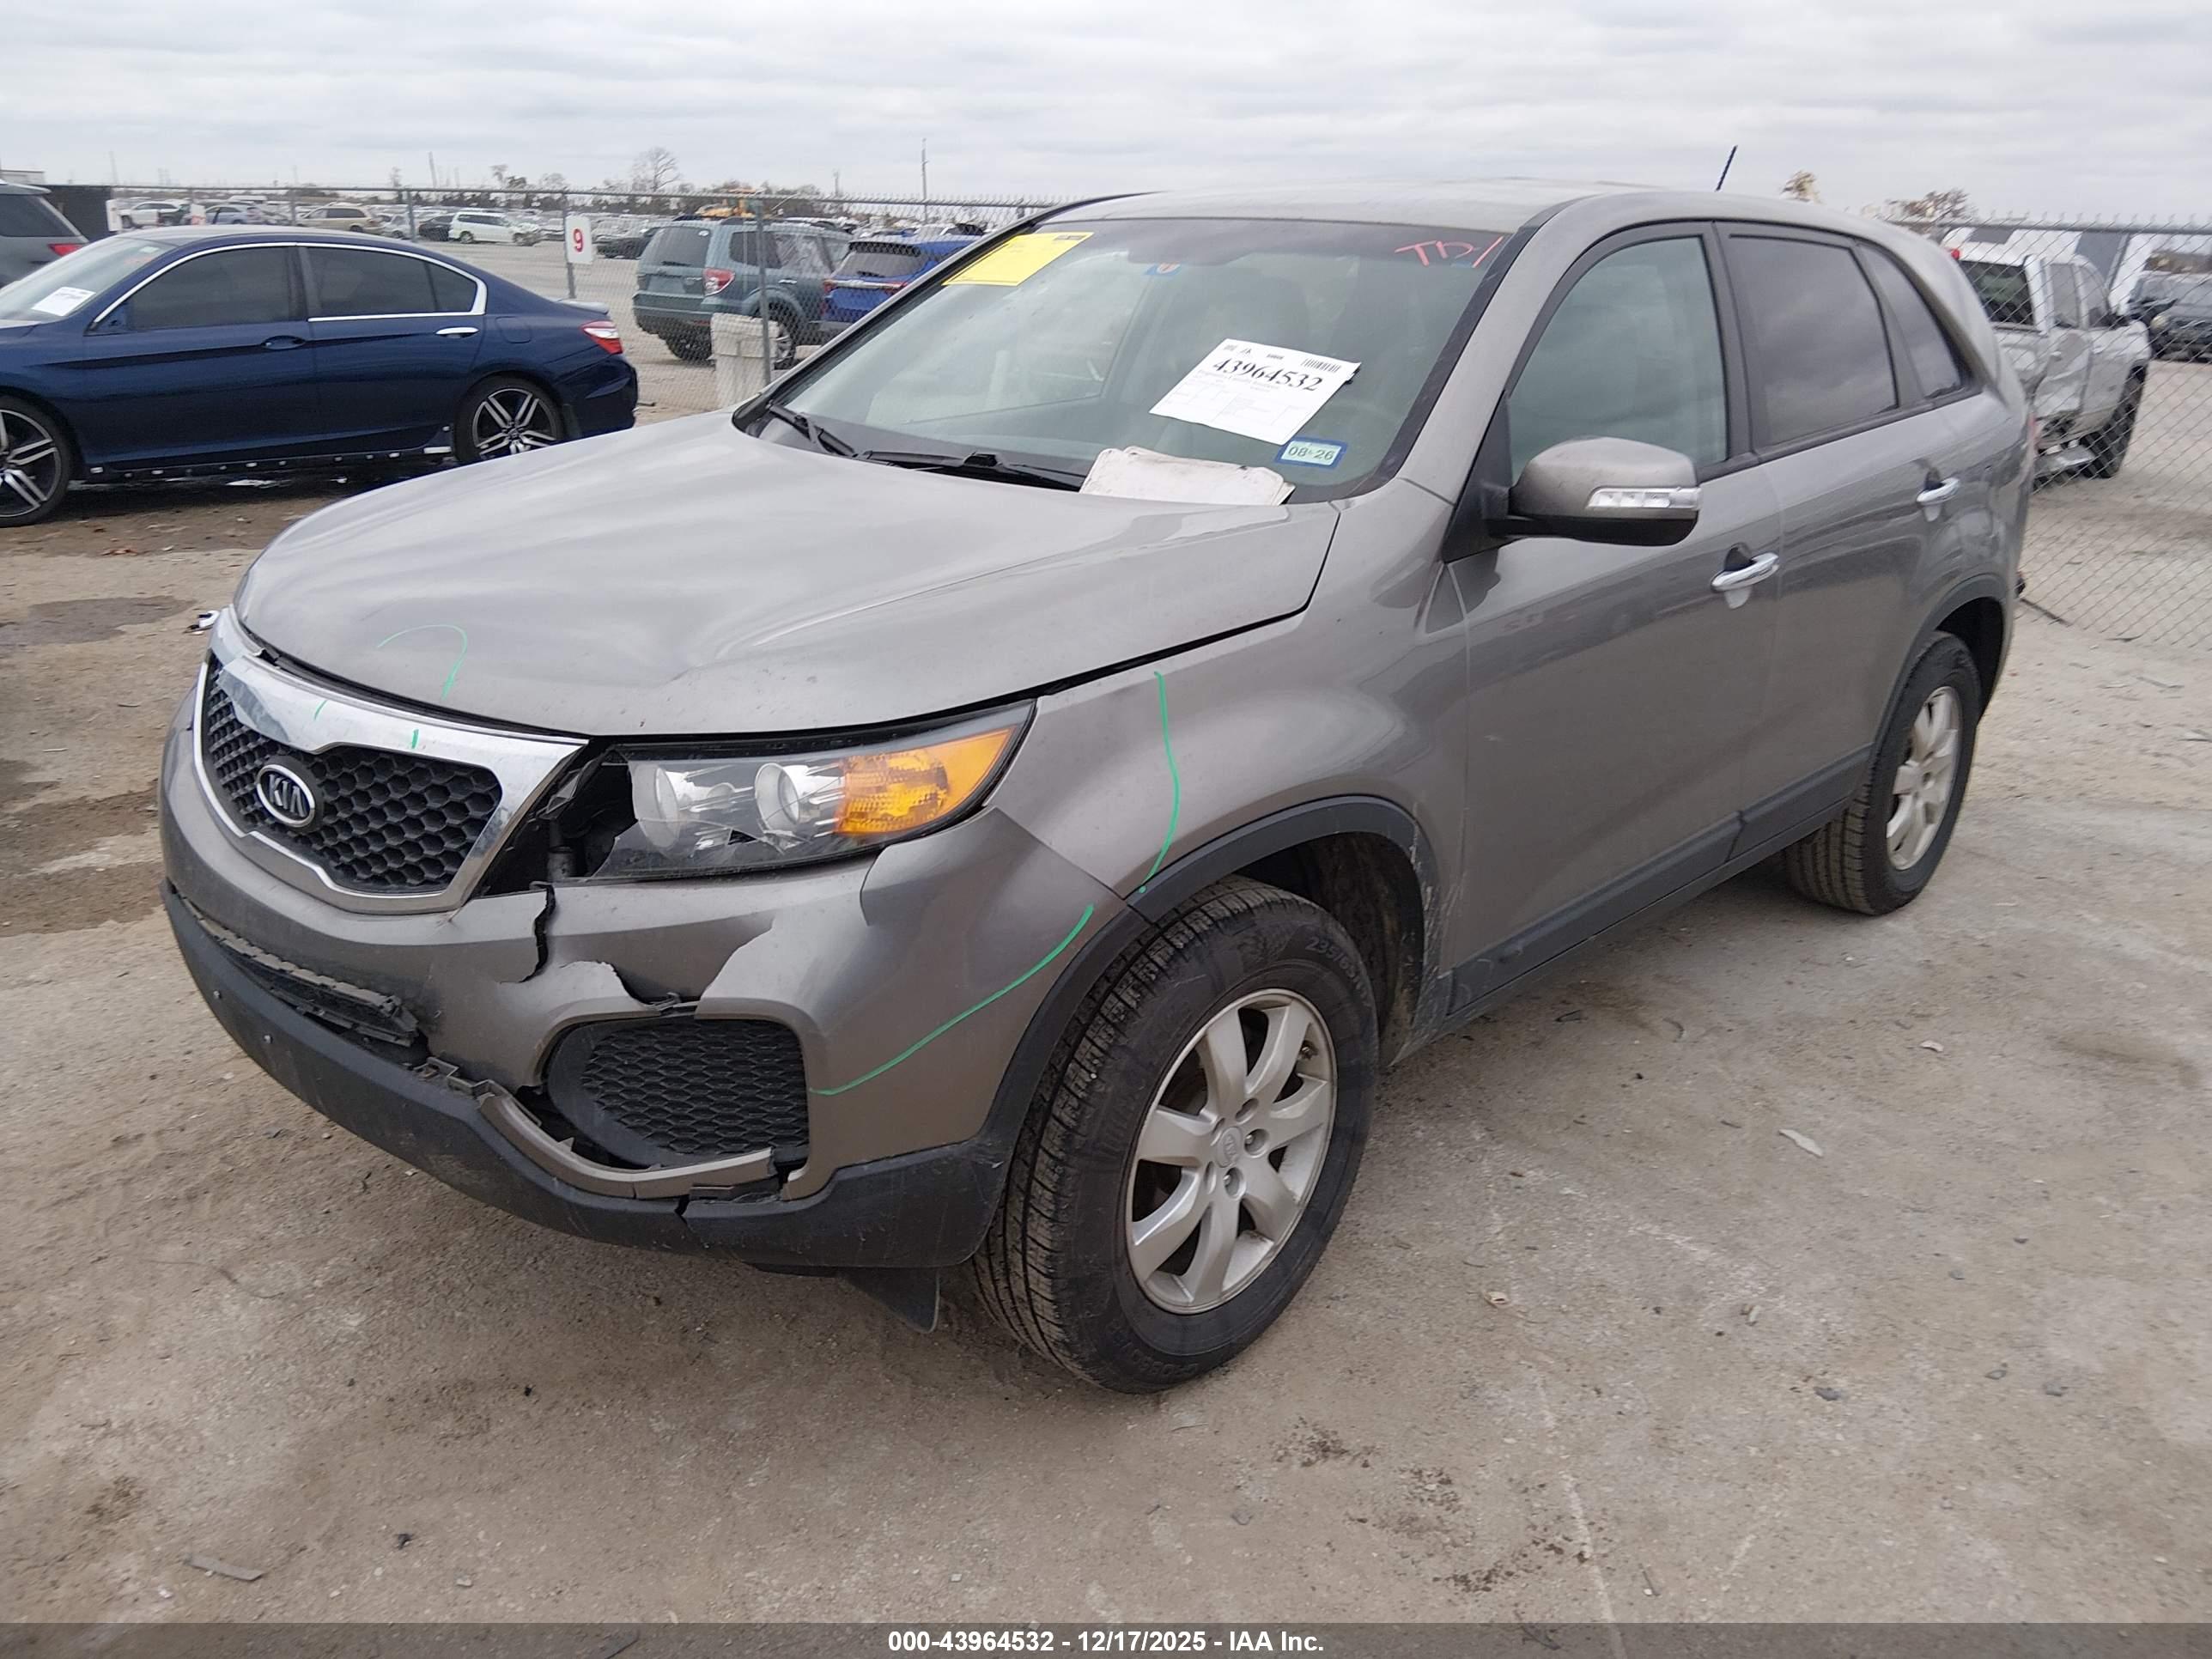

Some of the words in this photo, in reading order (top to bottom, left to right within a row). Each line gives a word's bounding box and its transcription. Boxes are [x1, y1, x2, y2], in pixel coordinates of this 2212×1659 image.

[573, 228, 584, 253] 9
[1212, 357, 1323, 392] 43964532
[1288, 446, 1309, 458] 08
[1314, 449, 1335, 461] 26
[269, 774, 307, 817] KIA
